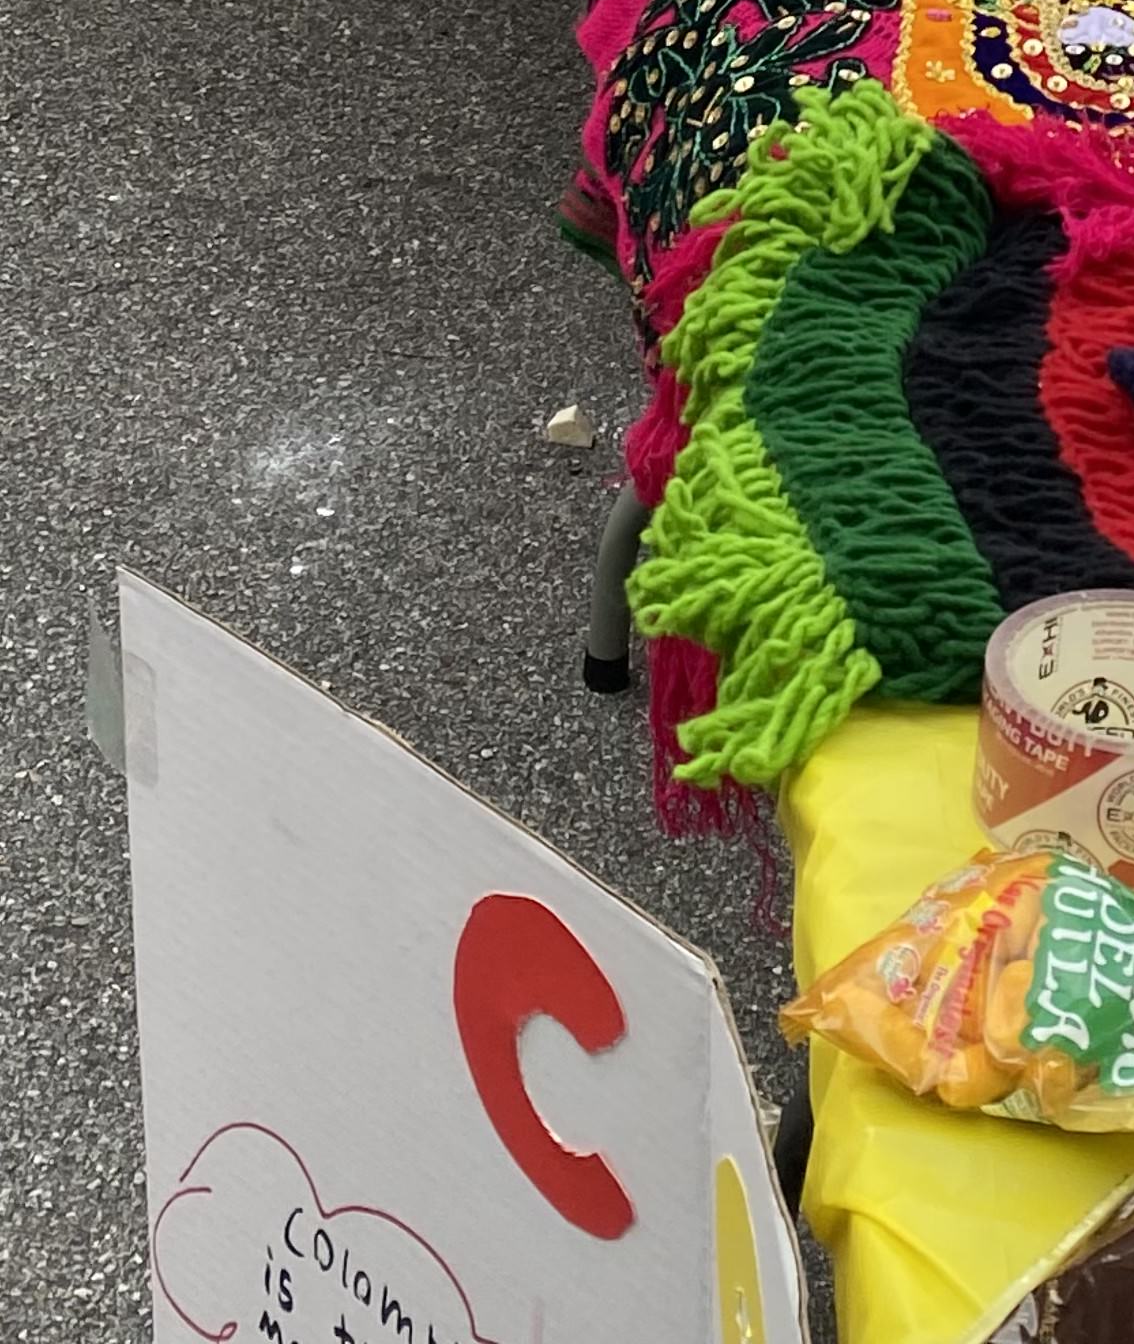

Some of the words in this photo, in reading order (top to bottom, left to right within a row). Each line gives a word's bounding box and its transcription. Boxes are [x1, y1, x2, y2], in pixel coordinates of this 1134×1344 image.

[1023, 735, 1070, 772] TAPE
[1030, 853, 1112, 1051] HUILA
[263, 1244, 294, 1313] is
